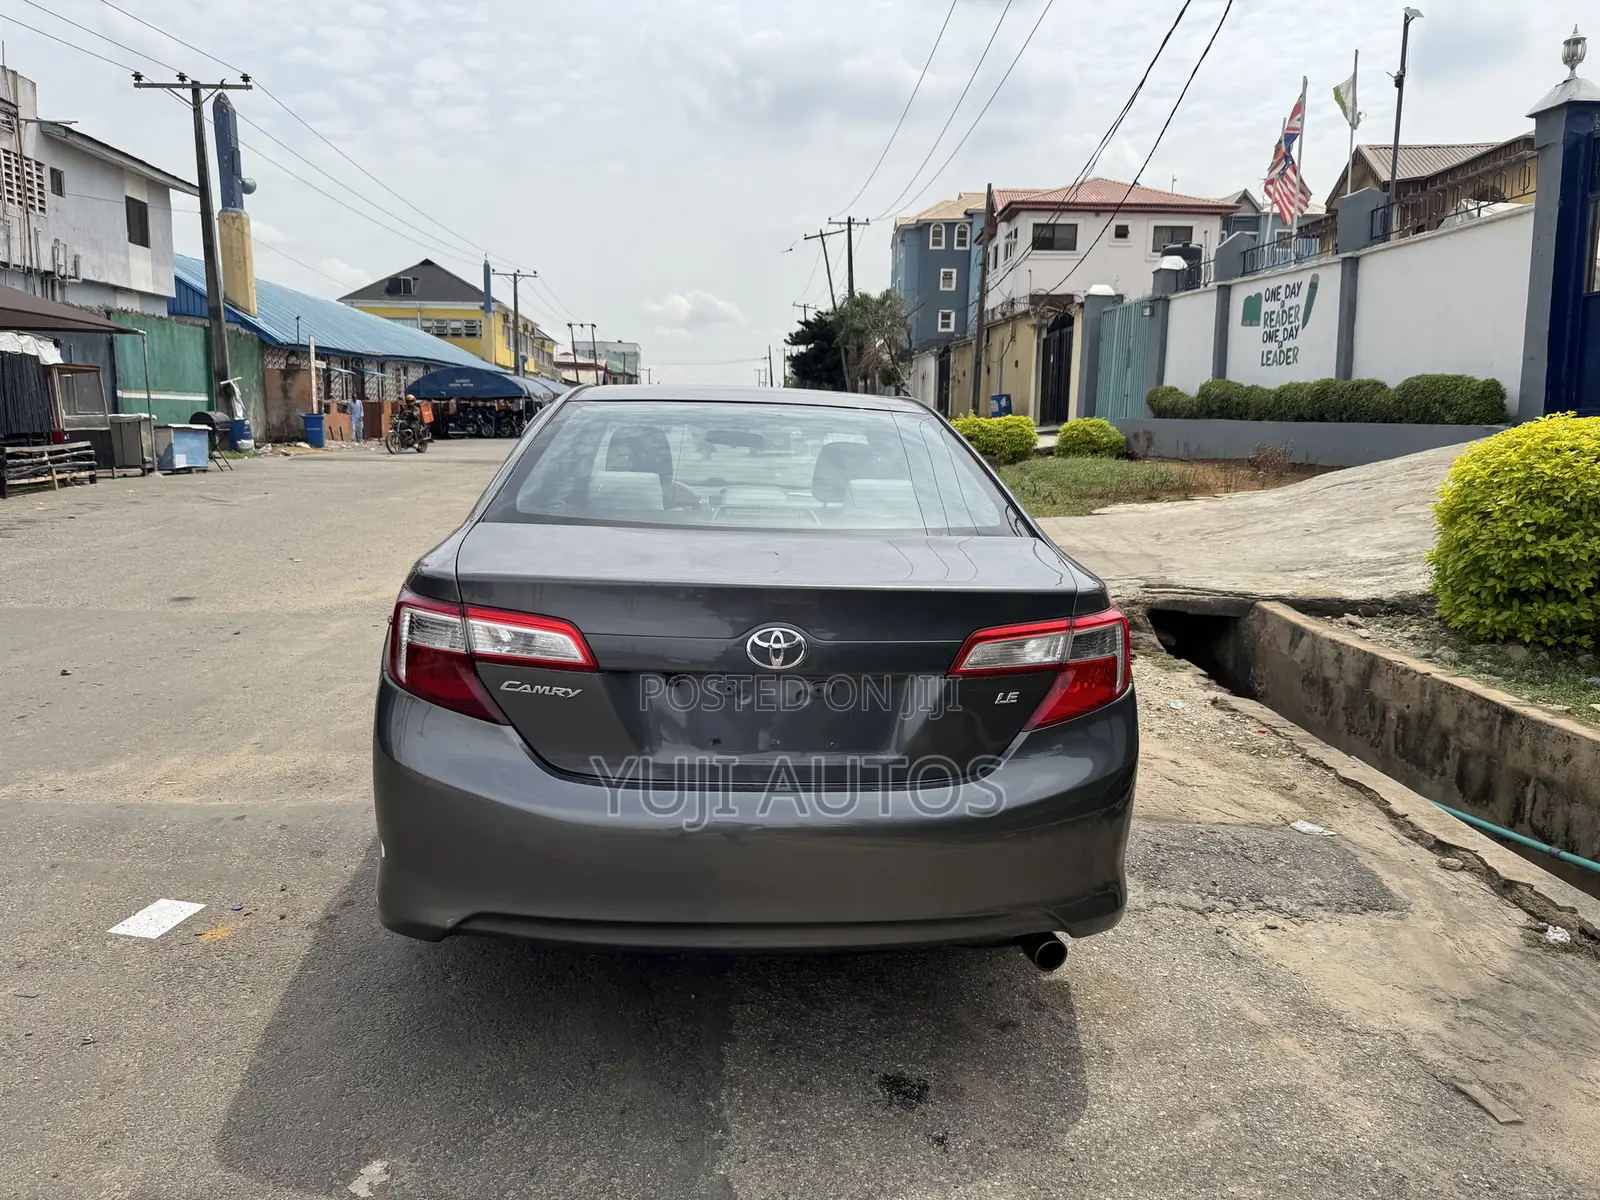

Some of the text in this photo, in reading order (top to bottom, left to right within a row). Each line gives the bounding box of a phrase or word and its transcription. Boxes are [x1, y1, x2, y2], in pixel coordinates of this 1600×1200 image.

[1264, 281, 1303, 303] ONE DAY
[1263, 304, 1301, 329] READER
[1262, 324, 1300, 344] ONE DAY
[1260, 346, 1300, 368] LEADER
[500, 680, 583, 698] CAMRY
[994, 691, 1020, 705] LE
